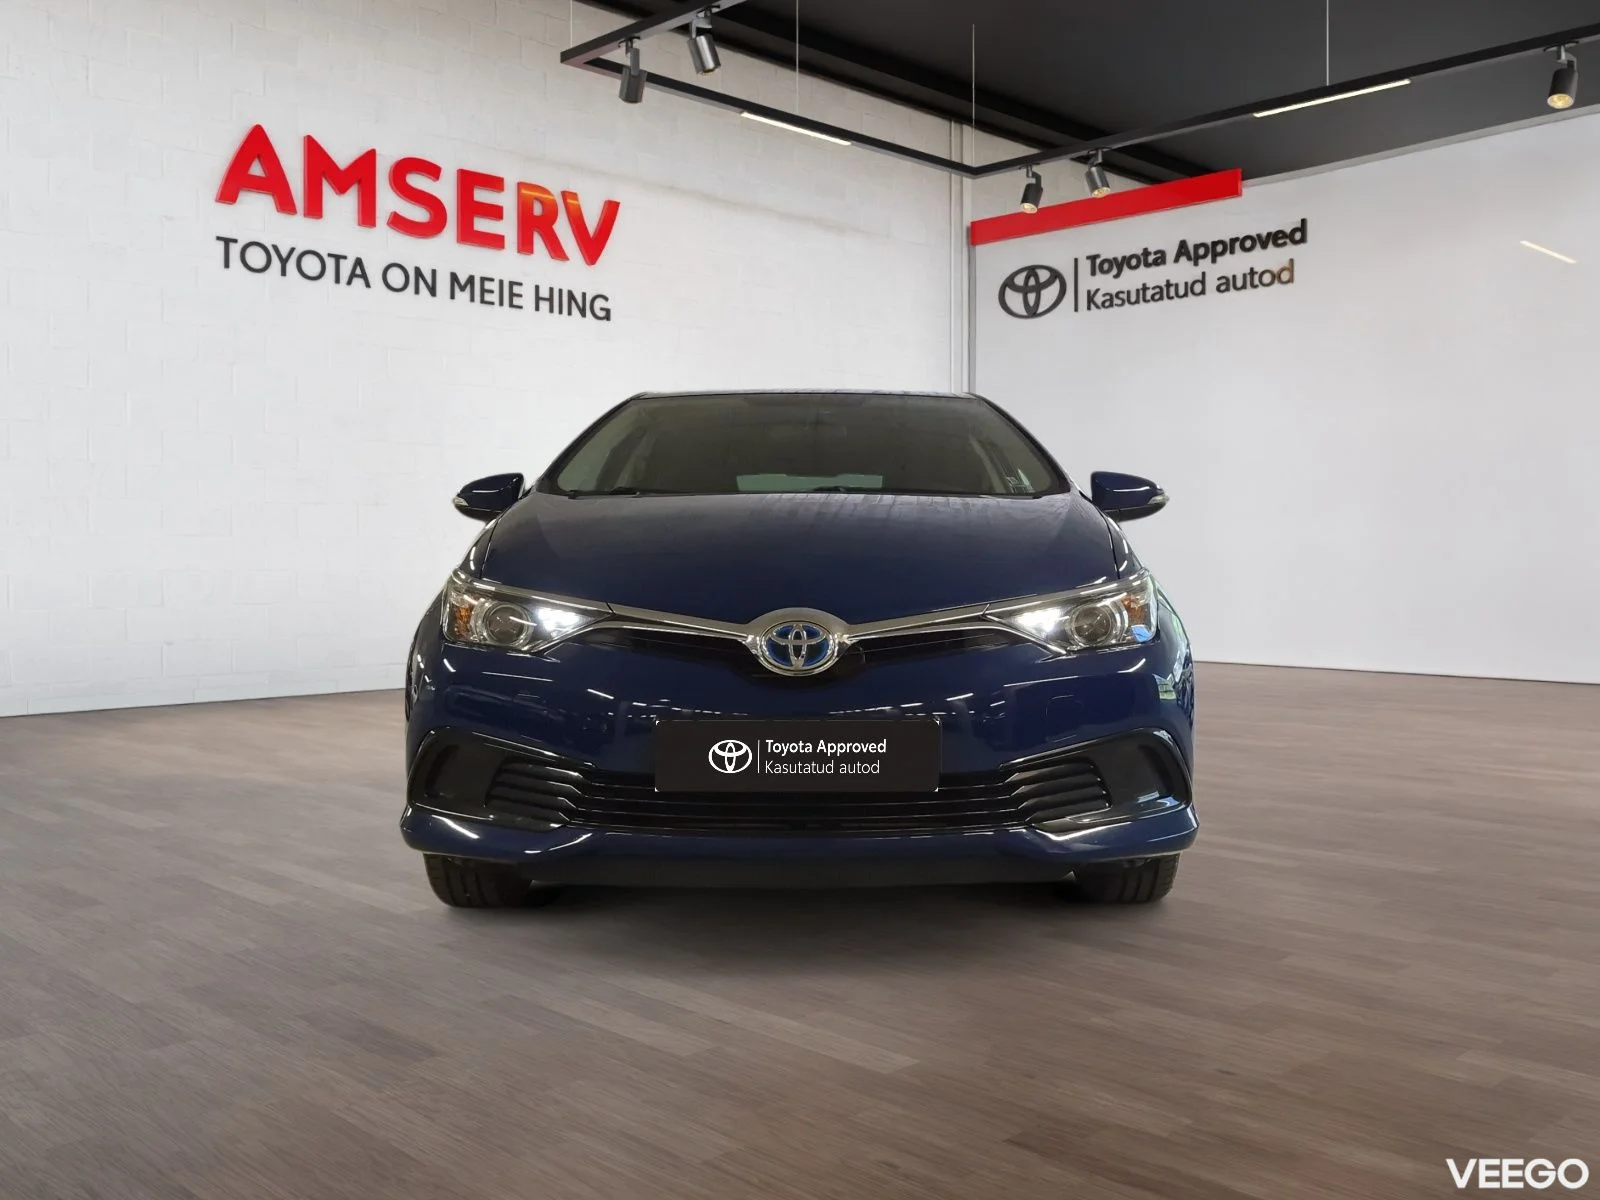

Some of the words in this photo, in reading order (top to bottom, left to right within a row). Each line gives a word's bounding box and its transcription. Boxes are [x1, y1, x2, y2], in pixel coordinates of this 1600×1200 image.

[215, 124, 620, 266] AMSERV
[1086, 247, 1166, 279] Toyota
[1174, 218, 1307, 266] Approved
[215, 236, 371, 289] TOYOTA
[381, 262, 437, 298] ON
[449, 272, 523, 310] MEIE
[534, 285, 611, 322] HING
[1086, 272, 1206, 311] Kasutatud
[1215, 258, 1295, 294] autod
[765, 739, 813, 756] Toyota
[817, 739, 887, 756] Approved
[765, 760, 834, 774] Kasutatud
[839, 760, 880, 774] autod
